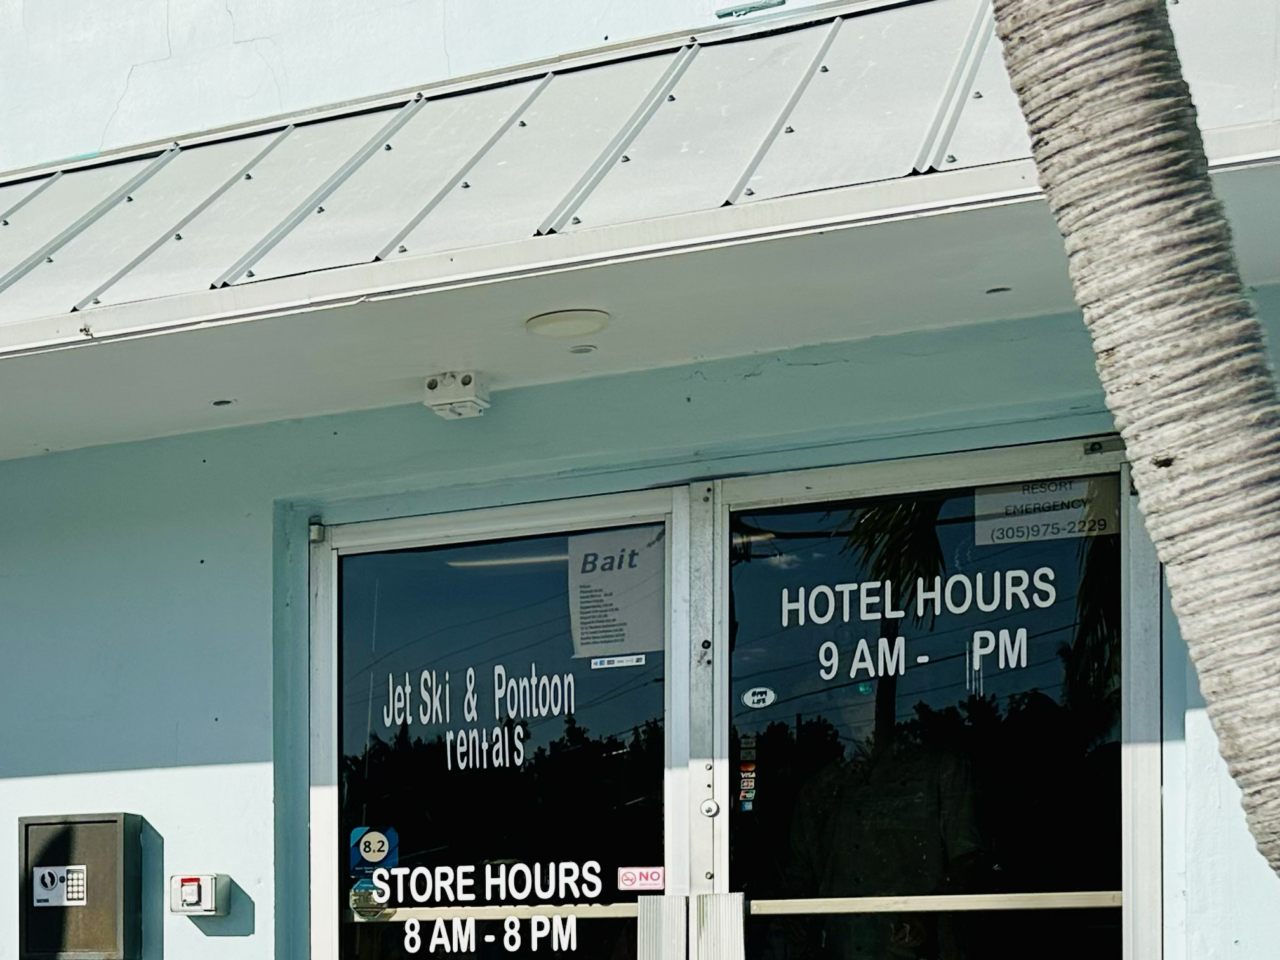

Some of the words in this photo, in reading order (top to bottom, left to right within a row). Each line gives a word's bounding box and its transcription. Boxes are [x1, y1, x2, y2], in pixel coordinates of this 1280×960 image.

[1022, 480, 1075, 495] RESORT
[1005, 498, 1088, 516] EMERGENCY
[990, 518, 1107, 543] (305)975-2229
[581, 548, 639, 574] Bait
[782, 579, 905, 627] HOTEL
[917, 567, 1056, 617] HOURS
[819, 641, 839, 680] 9
[850, 636, 905, 679] AM
[973, 628, 1028, 671] PM
[383, 672, 412, 727] Jet
[419, 669, 450, 725] Ski
[464, 667, 478, 722] &
[494, 662, 575, 720] Pontoon
[446, 725, 524, 771] rentals
[363, 840, 385, 853] 8.2
[372, 865, 476, 903] STORE
[485, 860, 603, 900] HOURS
[639, 871, 661, 881] NO
[404, 918, 422, 954] 8
[429, 917, 476, 953] AM
[503, 915, 521, 952] 8
[531, 914, 577, 951] PM
